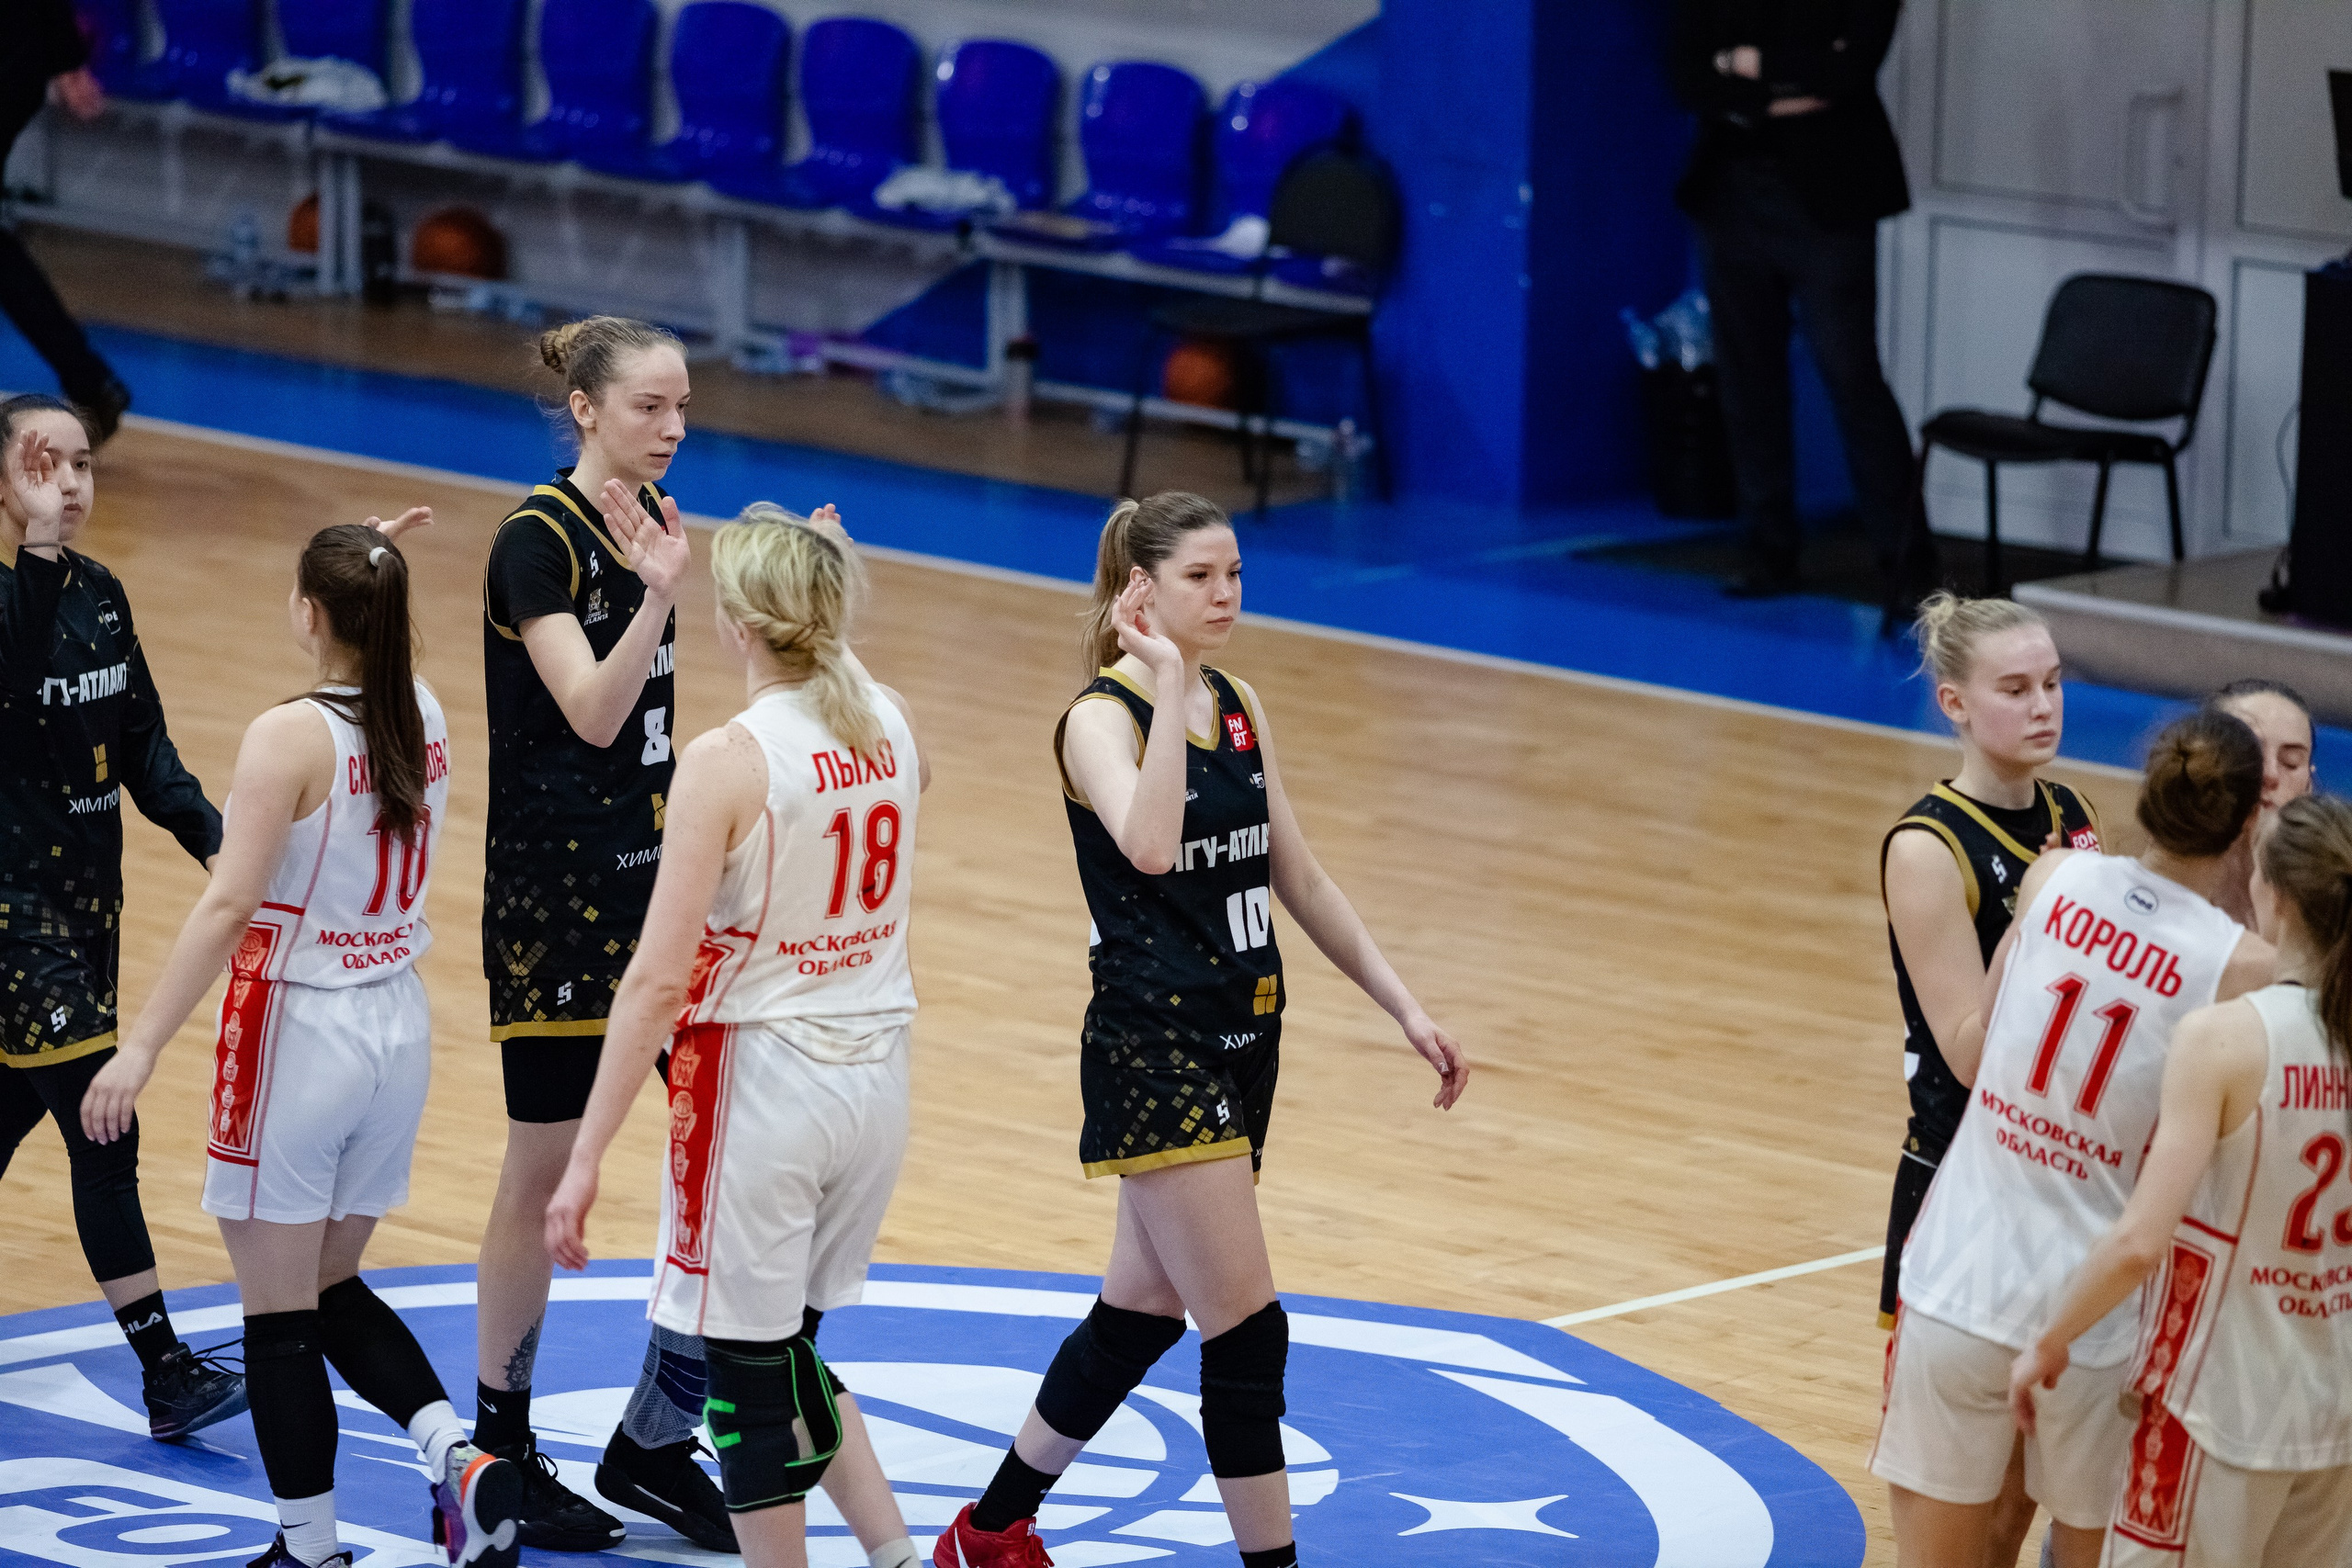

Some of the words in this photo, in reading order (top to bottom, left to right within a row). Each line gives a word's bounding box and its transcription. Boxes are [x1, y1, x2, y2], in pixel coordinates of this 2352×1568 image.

[640, 705, 671, 766] 8
[362, 803, 432, 917] 10
[822, 799, 902, 919] 18
[1227, 886, 1270, 953] 10
[2044, 894, 2183, 998] КОРОЛЬ
[2025, 971, 2141, 1121] 11
[2279, 1065, 2352, 1111] ЛИНН
[1996, 1126, 2088, 1181] ОБЛАСТЬ
[123, 1311, 164, 1335] ILA
